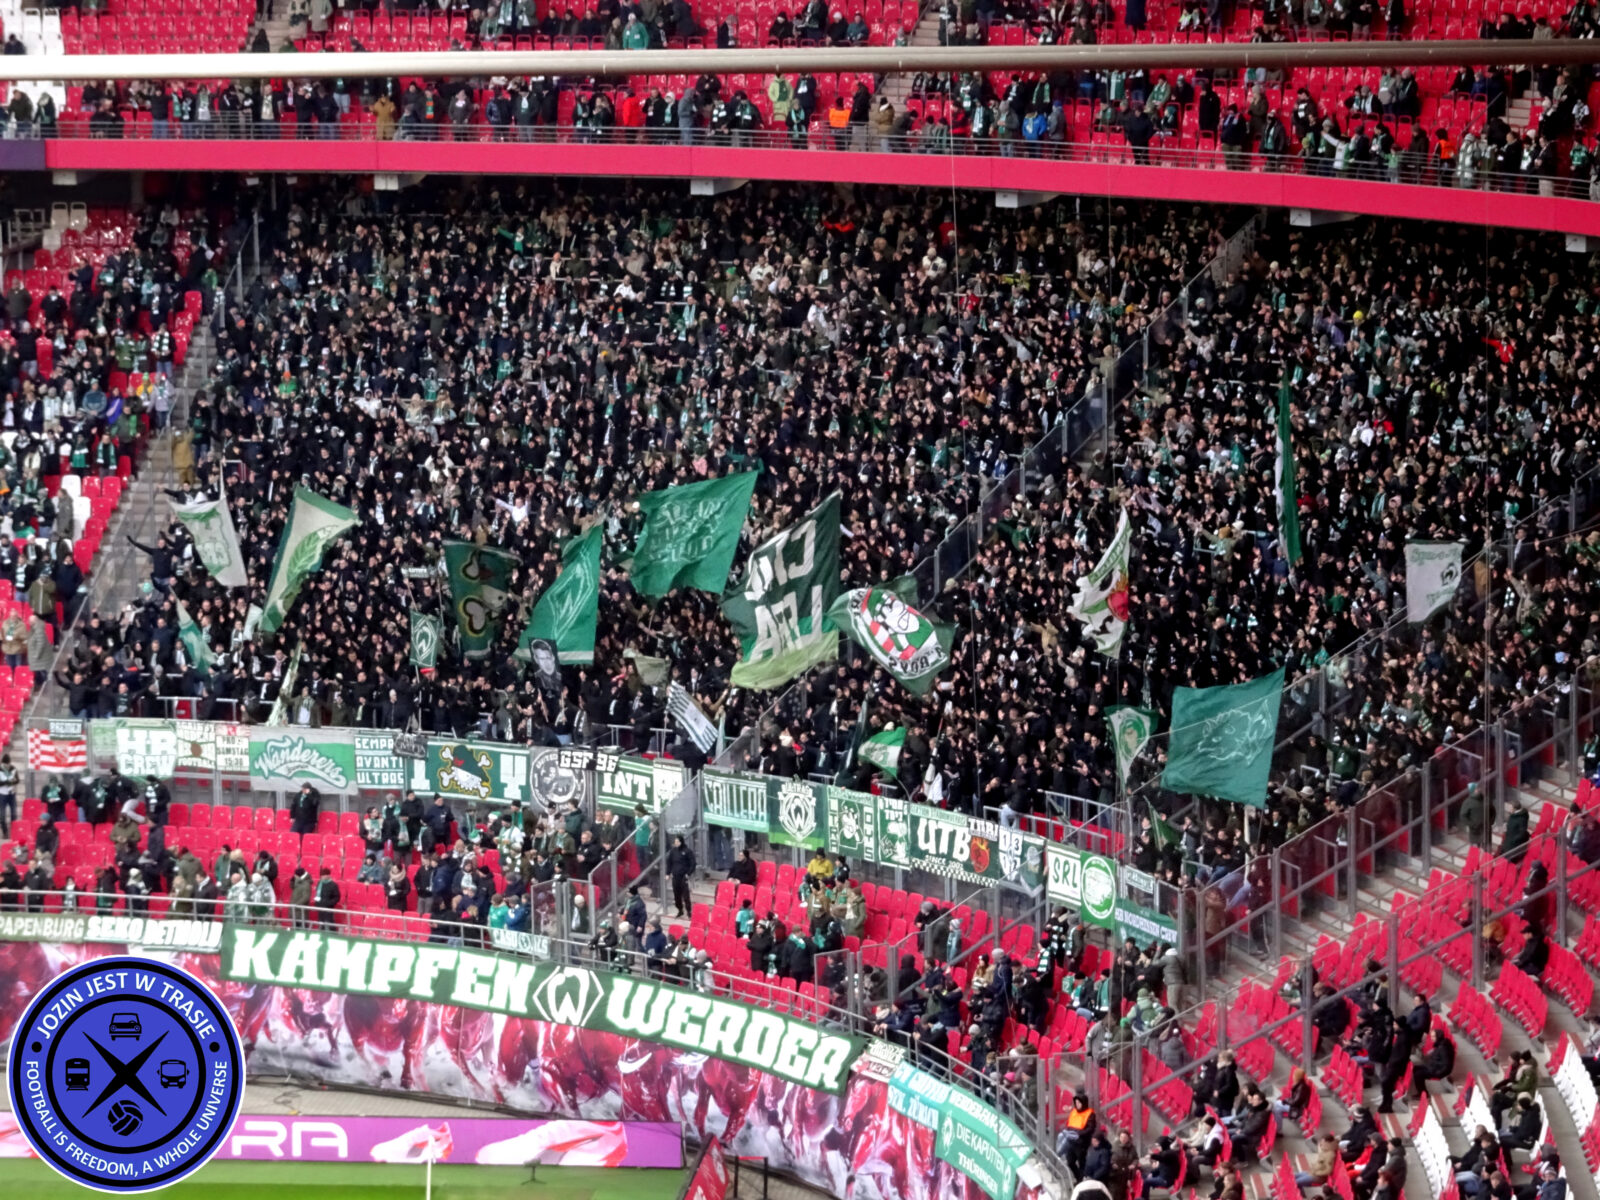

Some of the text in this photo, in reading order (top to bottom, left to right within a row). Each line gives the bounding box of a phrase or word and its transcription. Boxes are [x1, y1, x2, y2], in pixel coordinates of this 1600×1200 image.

[119, 754, 175, 776] CREW
[254, 736, 343, 780] Wanderers
[356, 756, 403, 769] AVANTI
[560, 751, 619, 773] GSF 96
[357, 772, 404, 784] ULTRAS
[704, 780, 767, 822] CAILLERA
[917, 818, 971, 862] UTB
[1053, 856, 1078, 889] SRL
[229, 928, 536, 1013] KÄMPFEN
[606, 977, 852, 1089] WERDER
[957, 1122, 971, 1146] DIE
[971, 1132, 1005, 1173] KAPUTTEN
